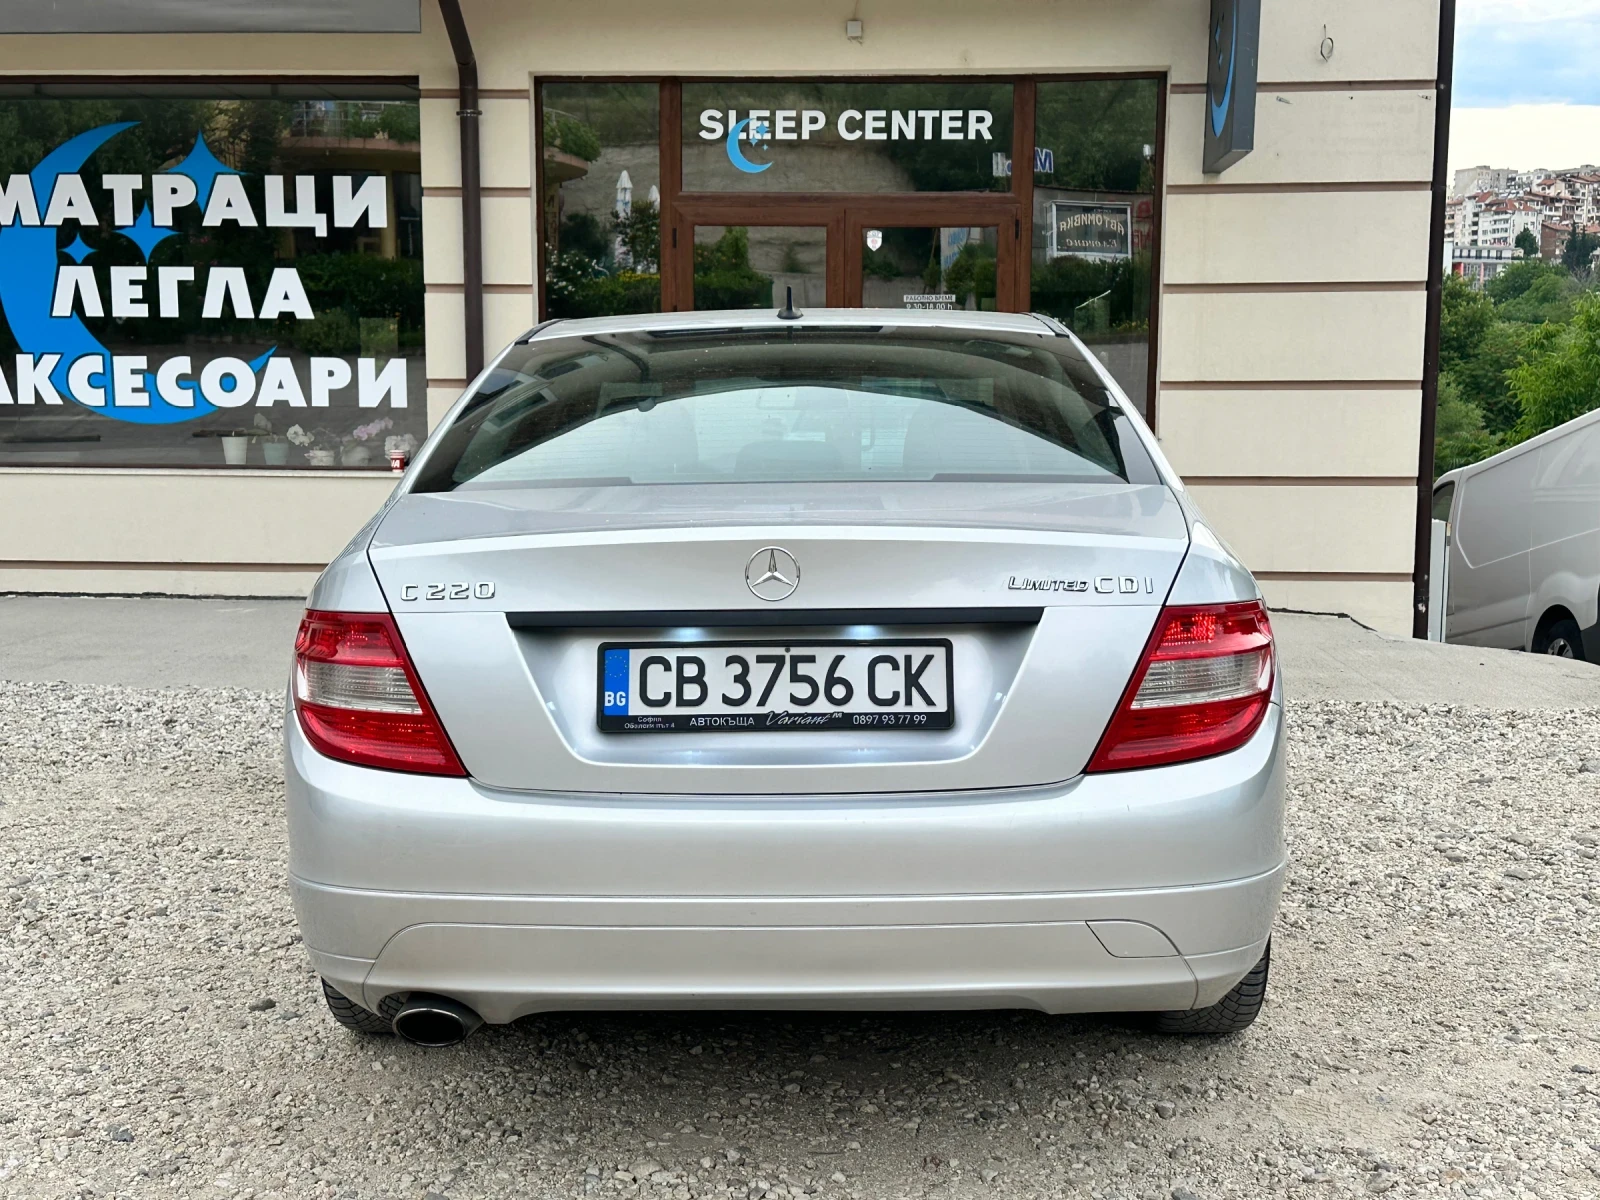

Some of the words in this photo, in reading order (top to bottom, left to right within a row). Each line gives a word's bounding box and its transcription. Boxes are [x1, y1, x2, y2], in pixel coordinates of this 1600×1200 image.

[699, 109, 826, 140] SLEEP
[837, 109, 993, 140] CENTER
[0, 174, 388, 238] МАТРАЦИ
[52, 265, 315, 320] ЛЕГЛА
[0, 354, 408, 409] КСЕСОАРИ
[400, 583, 419, 602] C
[425, 581, 497, 601] 220
[1008, 576, 1089, 593] LIMITED
[1094, 576, 1154, 594] CDI
[639, 655, 709, 708] CB
[721, 654, 854, 708] 3756
[867, 654, 937, 707] CK
[604, 691, 627, 707] BG
[689, 717, 755, 728] АВТОКЪЩА
[765, 711, 831, 726] Variant
[853, 715, 879, 725] 0897
[882, 715, 896, 724] 93
[898, 715, 912, 724] 77
[913, 714, 928, 724] 99
